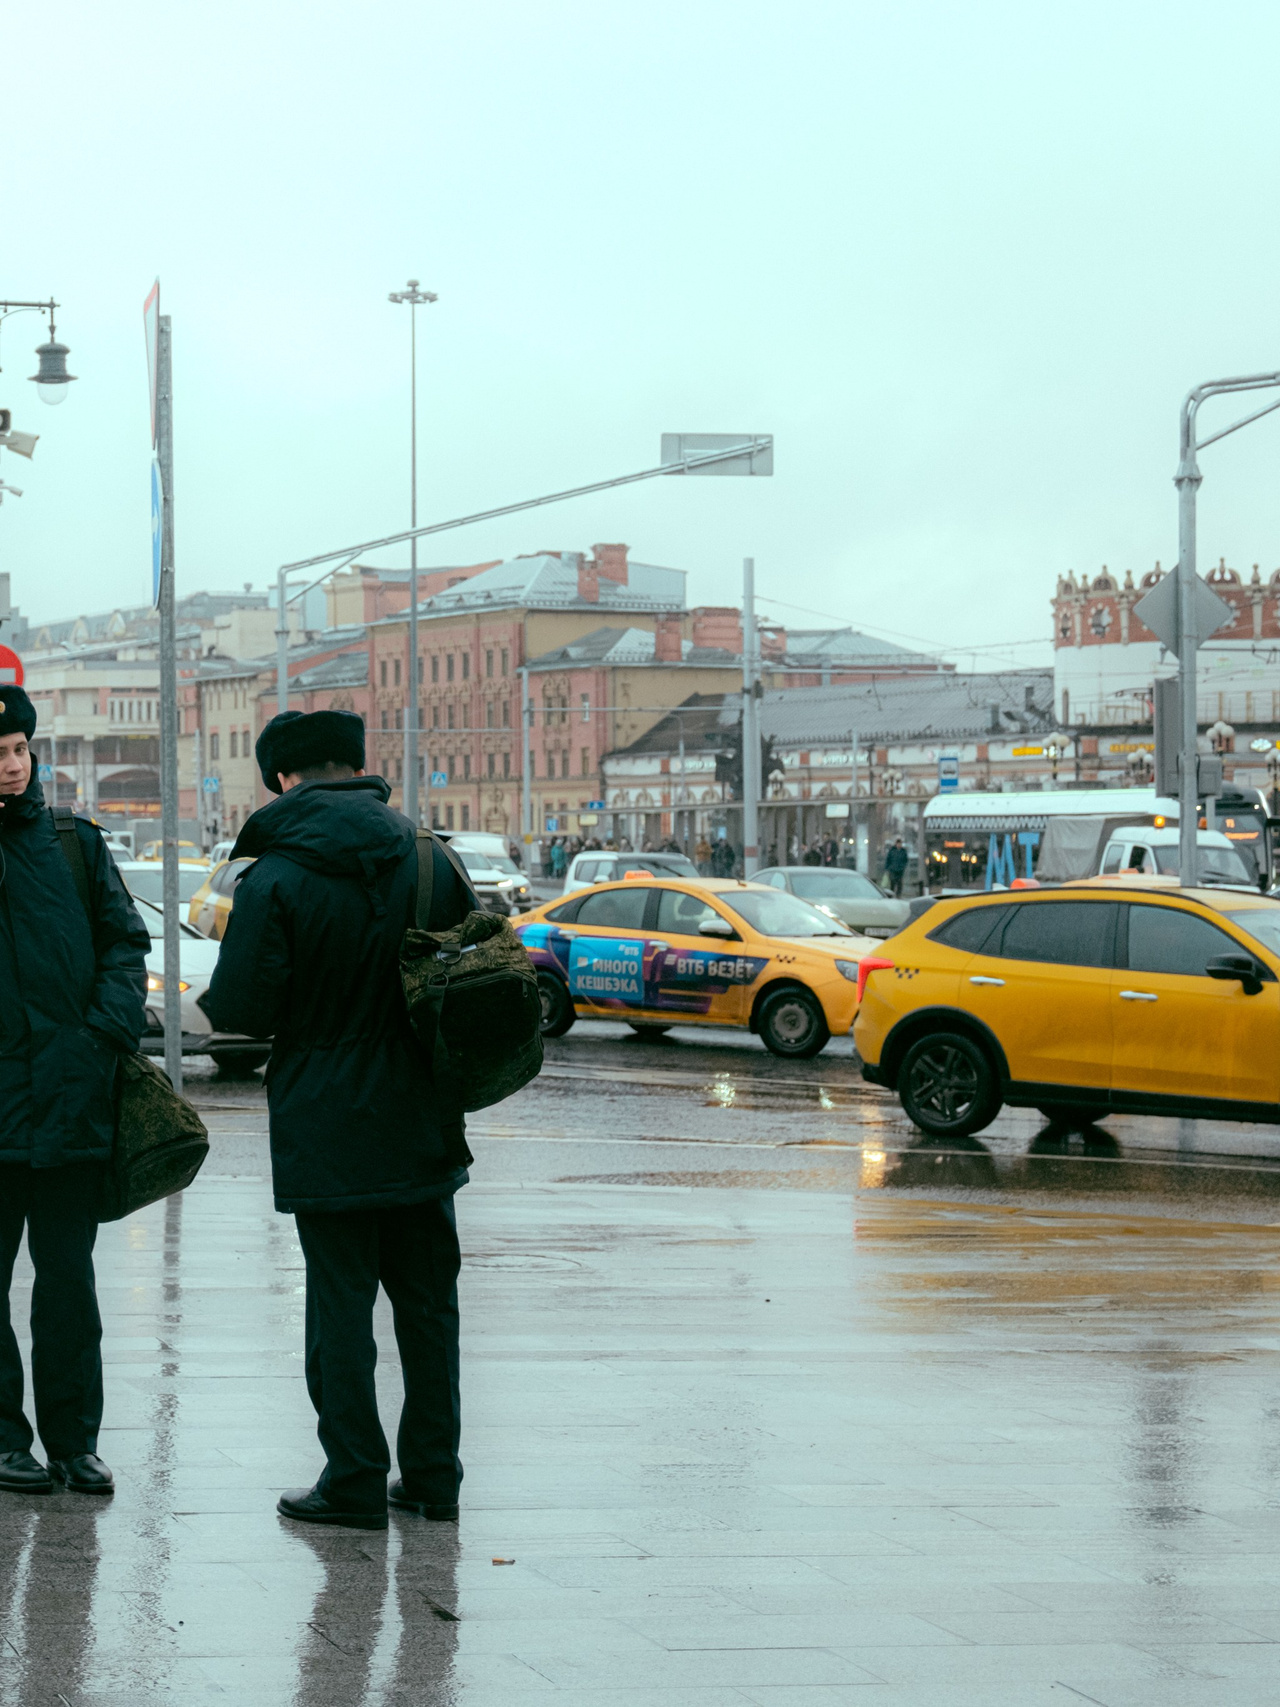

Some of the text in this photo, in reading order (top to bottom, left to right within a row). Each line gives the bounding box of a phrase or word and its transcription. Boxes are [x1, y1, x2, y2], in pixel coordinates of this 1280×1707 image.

[624, 946, 639, 956] ВТБ
[592, 958, 638, 975] МНОГО
[677, 957, 755, 979] ВТБ ВЕЗЁТ
[577, 975, 639, 993] КЕШБЭКА
